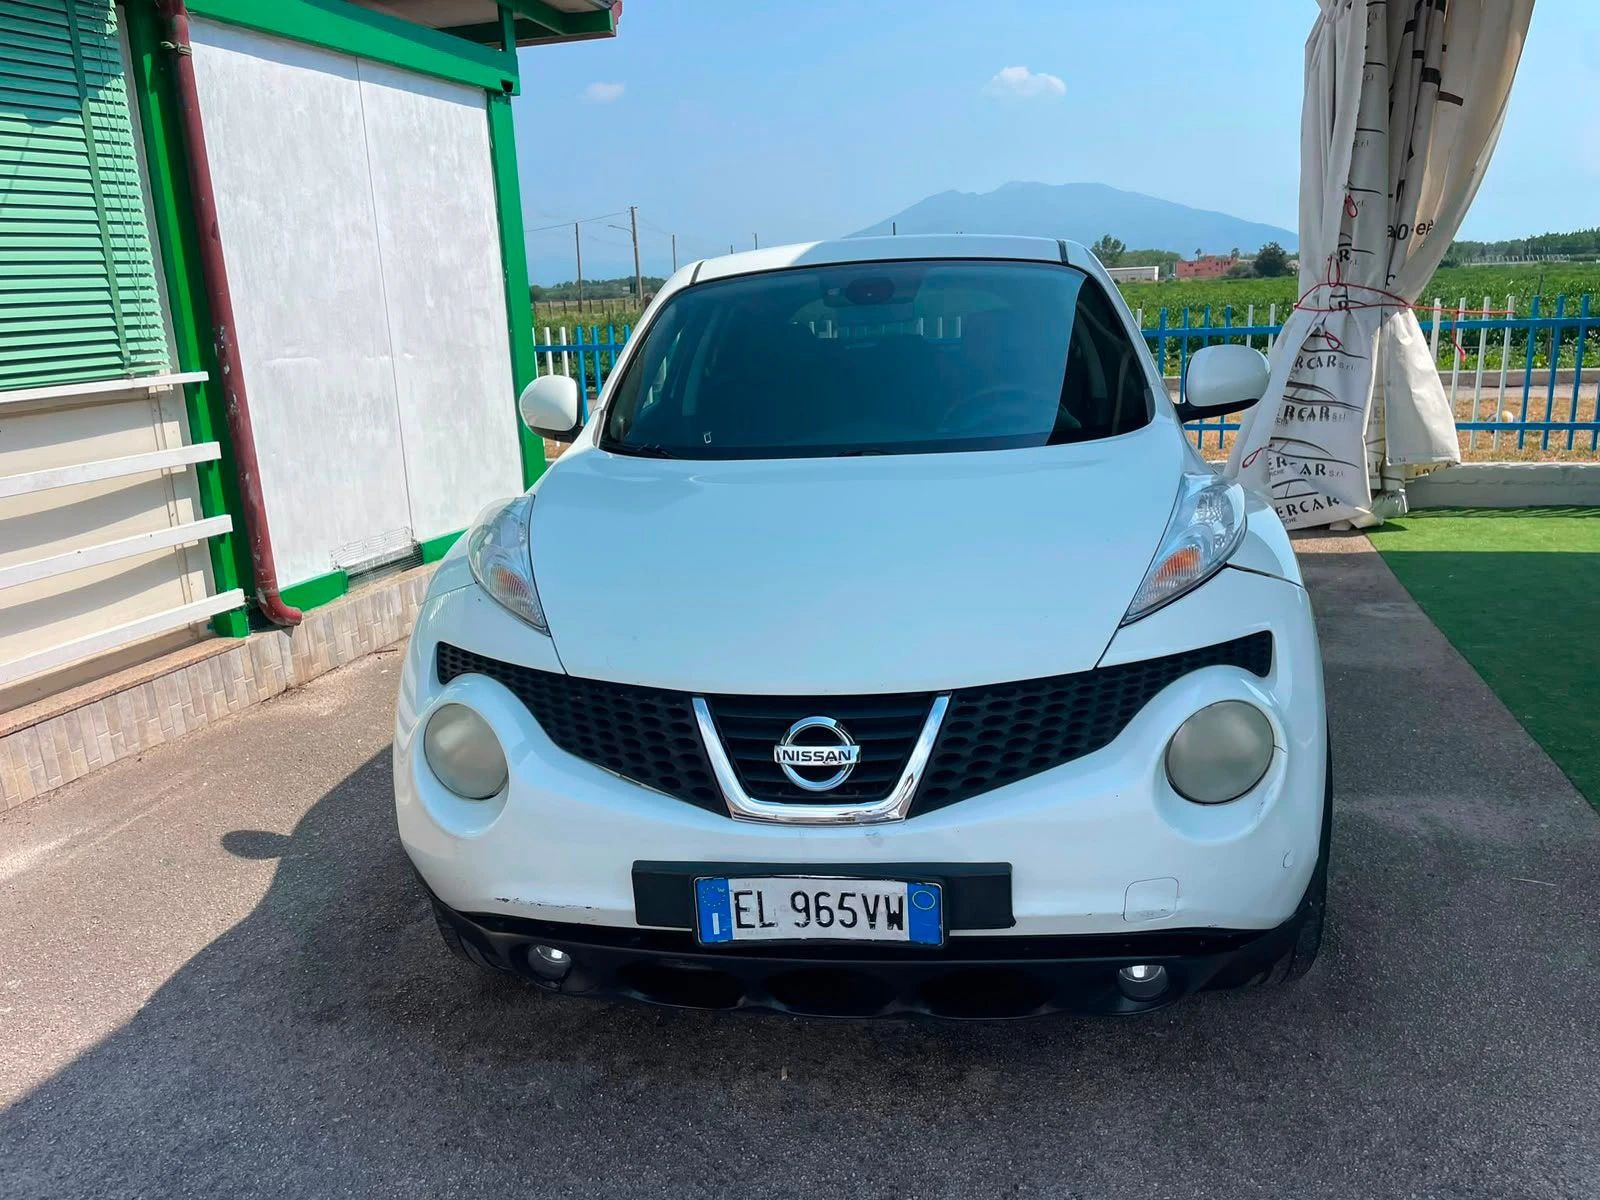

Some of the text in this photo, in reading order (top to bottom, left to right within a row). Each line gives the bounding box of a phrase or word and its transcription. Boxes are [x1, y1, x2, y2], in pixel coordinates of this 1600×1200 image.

[1277, 405, 1330, 422] RCAR
[782, 749, 851, 762] NISSAN
[734, 889, 778, 929] EL
[790, 890, 904, 931] 965VW
